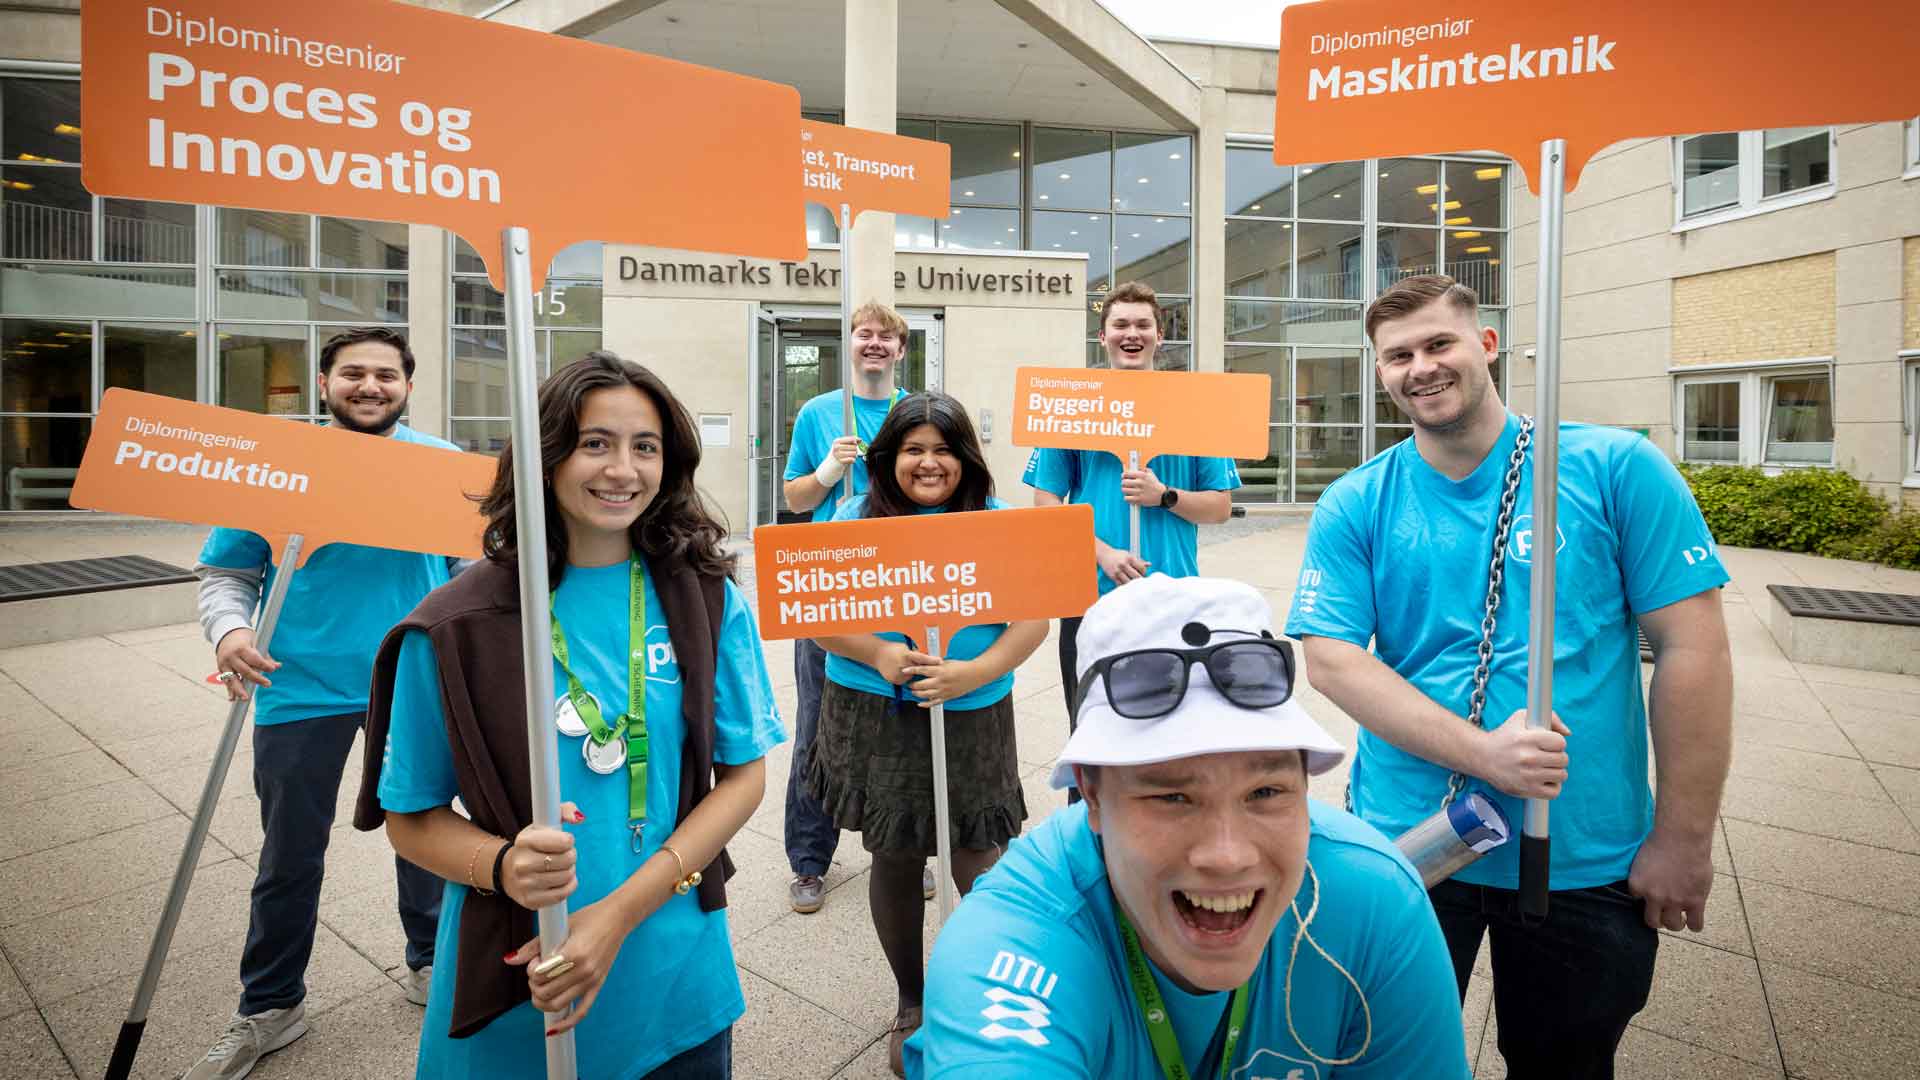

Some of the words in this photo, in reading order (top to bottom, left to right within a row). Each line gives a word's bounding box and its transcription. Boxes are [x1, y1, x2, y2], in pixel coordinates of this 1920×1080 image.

[147, 7, 405, 75] Diplomingeniør
[1310, 17, 1474, 57] Diplomingeniør
[1308, 35, 1616, 101] Maskinteknik
[148, 52, 378, 129] Proces
[400, 101, 472, 152] og
[148, 118, 500, 204] Innovation
[833, 151, 915, 180] Transport
[619, 256, 771, 285] Danmarks
[917, 266, 1073, 295] Universitet
[1029, 393, 1104, 416] Byggeri
[1110, 400, 1135, 418] og
[125, 416, 258, 451] Diplomingeniør
[1026, 416, 1155, 438] Infrastruktur
[114, 440, 309, 493] Produktion
[776, 545, 878, 564] Diplomingeniør
[777, 560, 934, 594] Skibsteknik
[944, 561, 977, 588] og
[779, 597, 894, 624] Maritimt
[902, 588, 992, 616] Design
[986, 950, 1058, 1000] DTU
